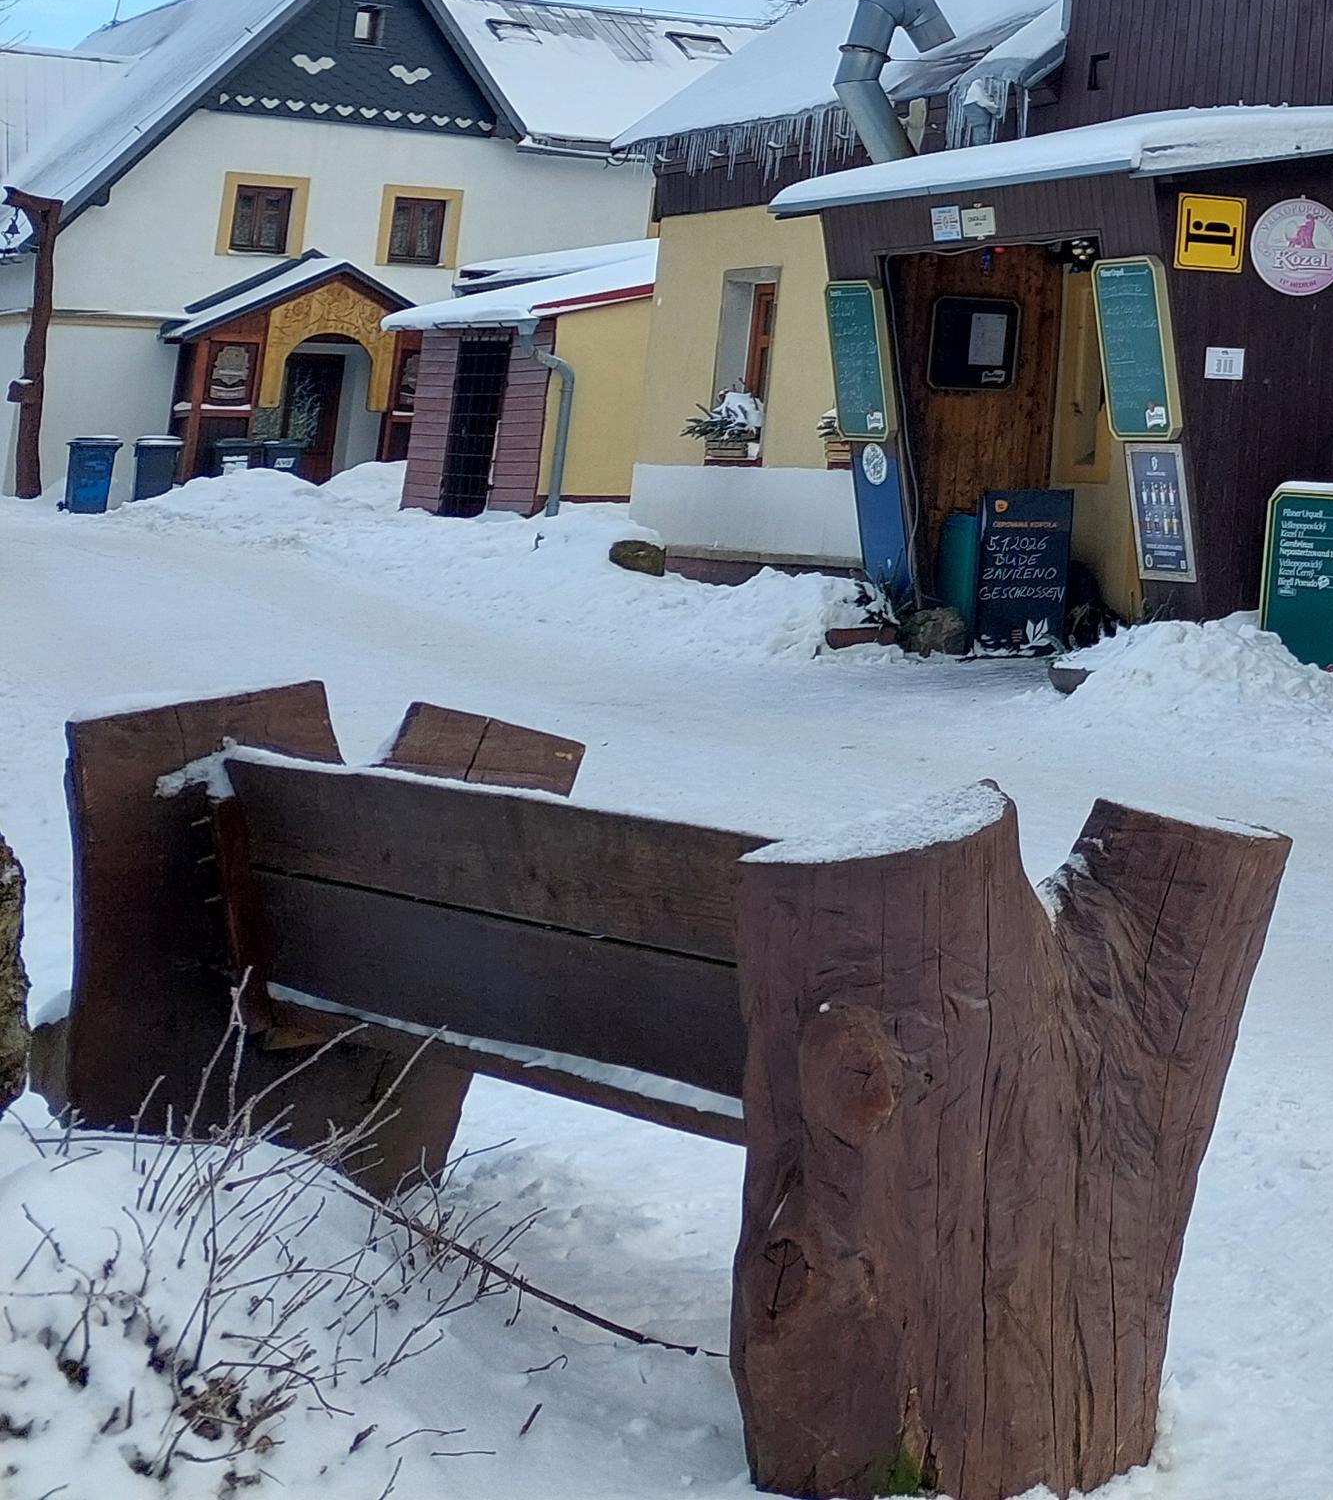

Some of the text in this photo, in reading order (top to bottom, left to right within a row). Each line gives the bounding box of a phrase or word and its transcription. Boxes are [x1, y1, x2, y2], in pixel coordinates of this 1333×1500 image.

[1271, 249, 1333, 272] Kozel
[986, 535, 1050, 552] 5.1.2026
[992, 553, 1043, 566] BUDE
[982, 566, 1057, 581] ZAVŘENO
